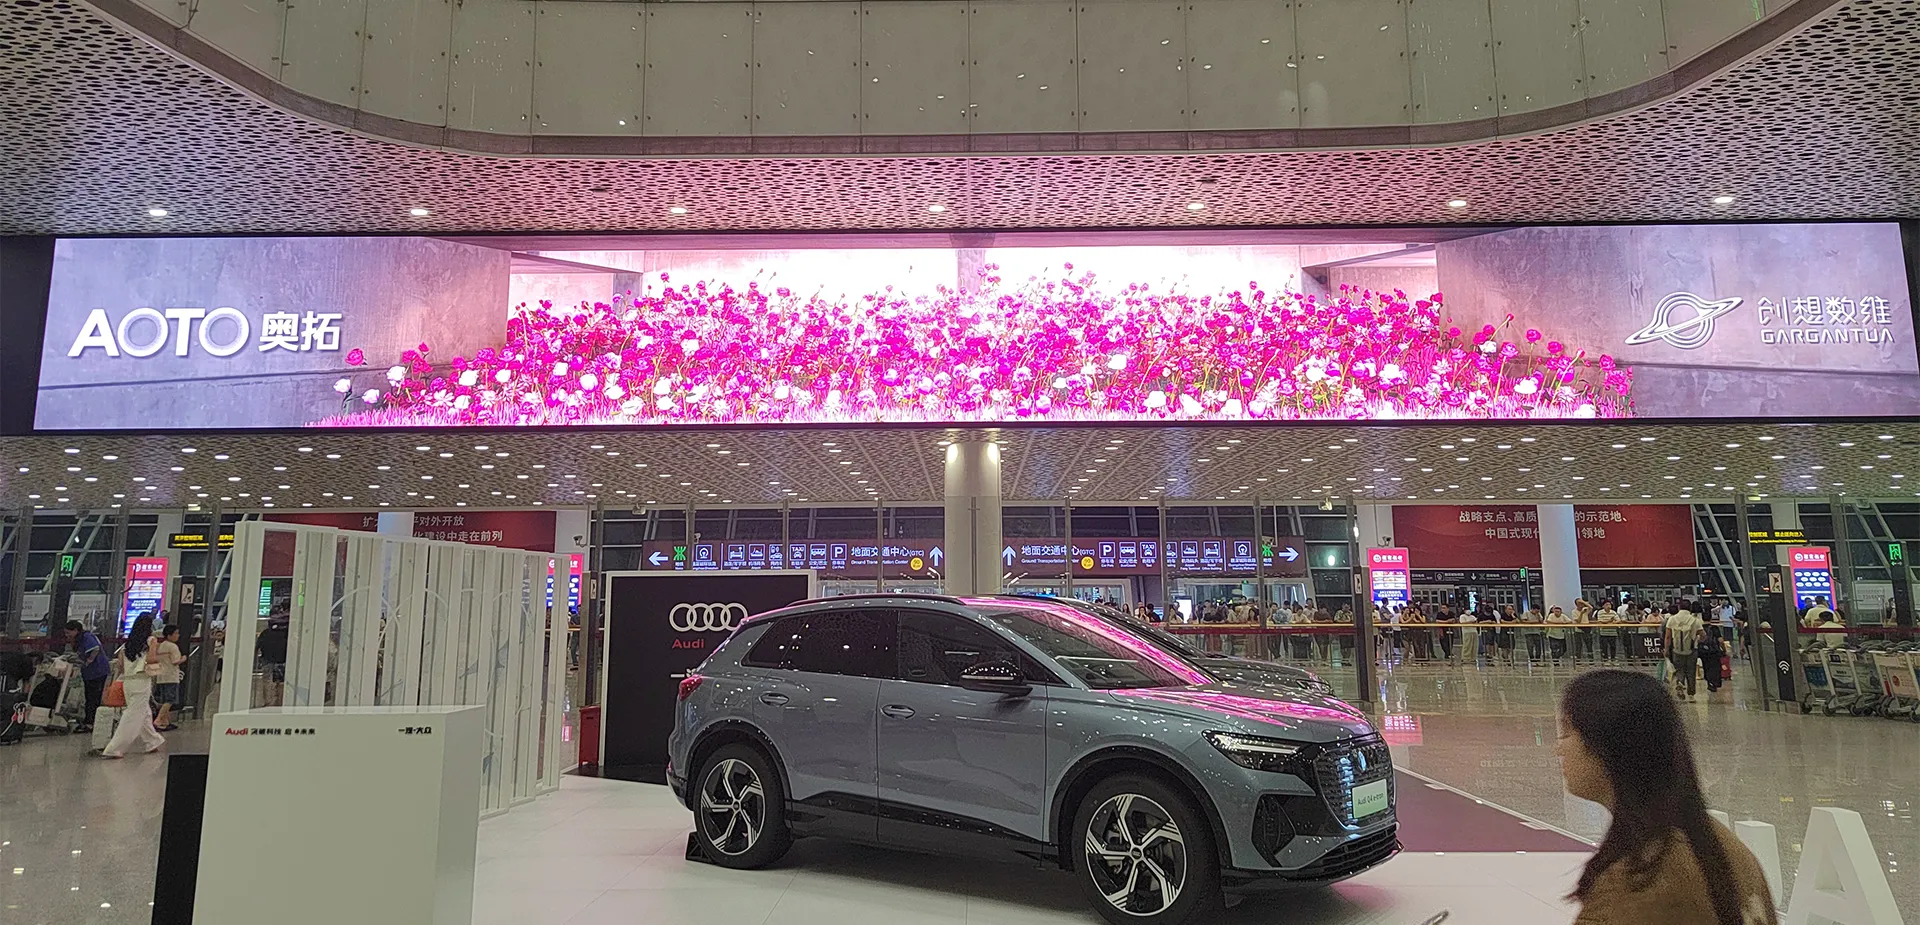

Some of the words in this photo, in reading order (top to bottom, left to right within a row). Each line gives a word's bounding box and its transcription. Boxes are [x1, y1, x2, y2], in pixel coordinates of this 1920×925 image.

[1757, 295, 1893, 325] 创想数维
[67, 307, 249, 357] AOTO
[258, 310, 342, 352] 奥拓
[1761, 328, 1895, 343] GARGANTUA
[672, 639, 704, 649] Audi
[225, 728, 248, 736] Audi
